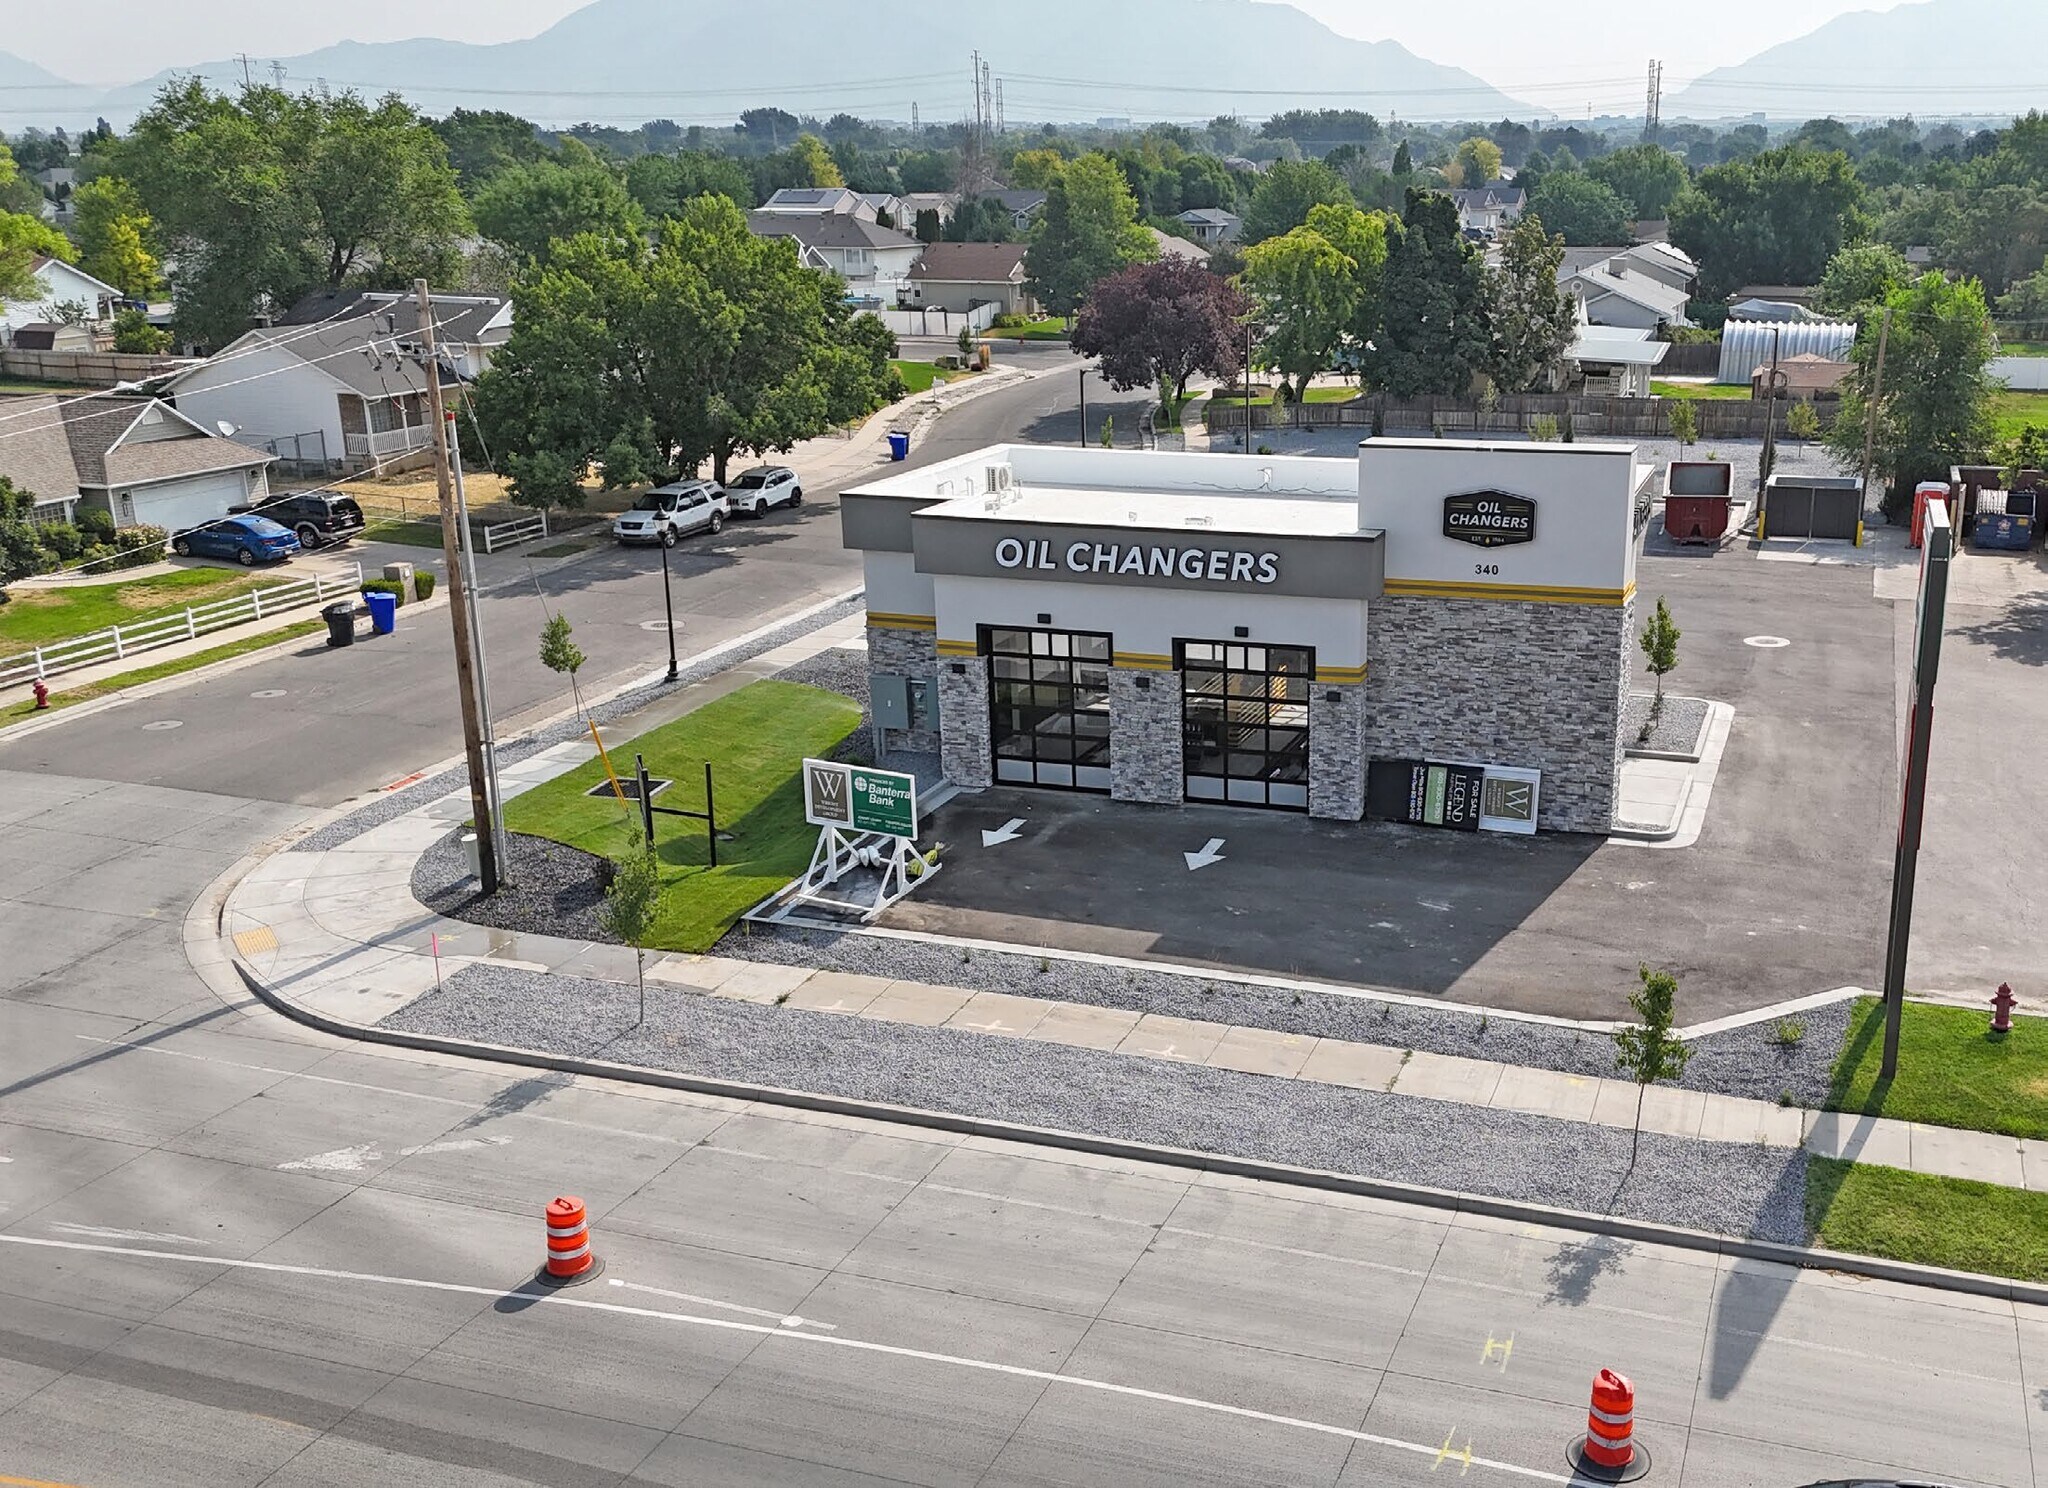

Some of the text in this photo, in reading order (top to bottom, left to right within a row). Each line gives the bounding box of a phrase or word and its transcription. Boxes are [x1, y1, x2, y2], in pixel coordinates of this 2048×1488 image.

[1477, 501, 1502, 514] OIL
[1449, 513, 1529, 529] CHANGERS
[995, 538, 1280, 584] OIL CHANGERS
[1474, 564, 1499, 575] 340
[813, 770, 843, 799] W
[868, 783, 911, 799] Banterra
[869, 794, 895, 807] Bank
[1451, 774, 1467, 822] LEGEND
[1469, 780, 1480, 819] FOR SALE
[1505, 784, 1529, 817] W
